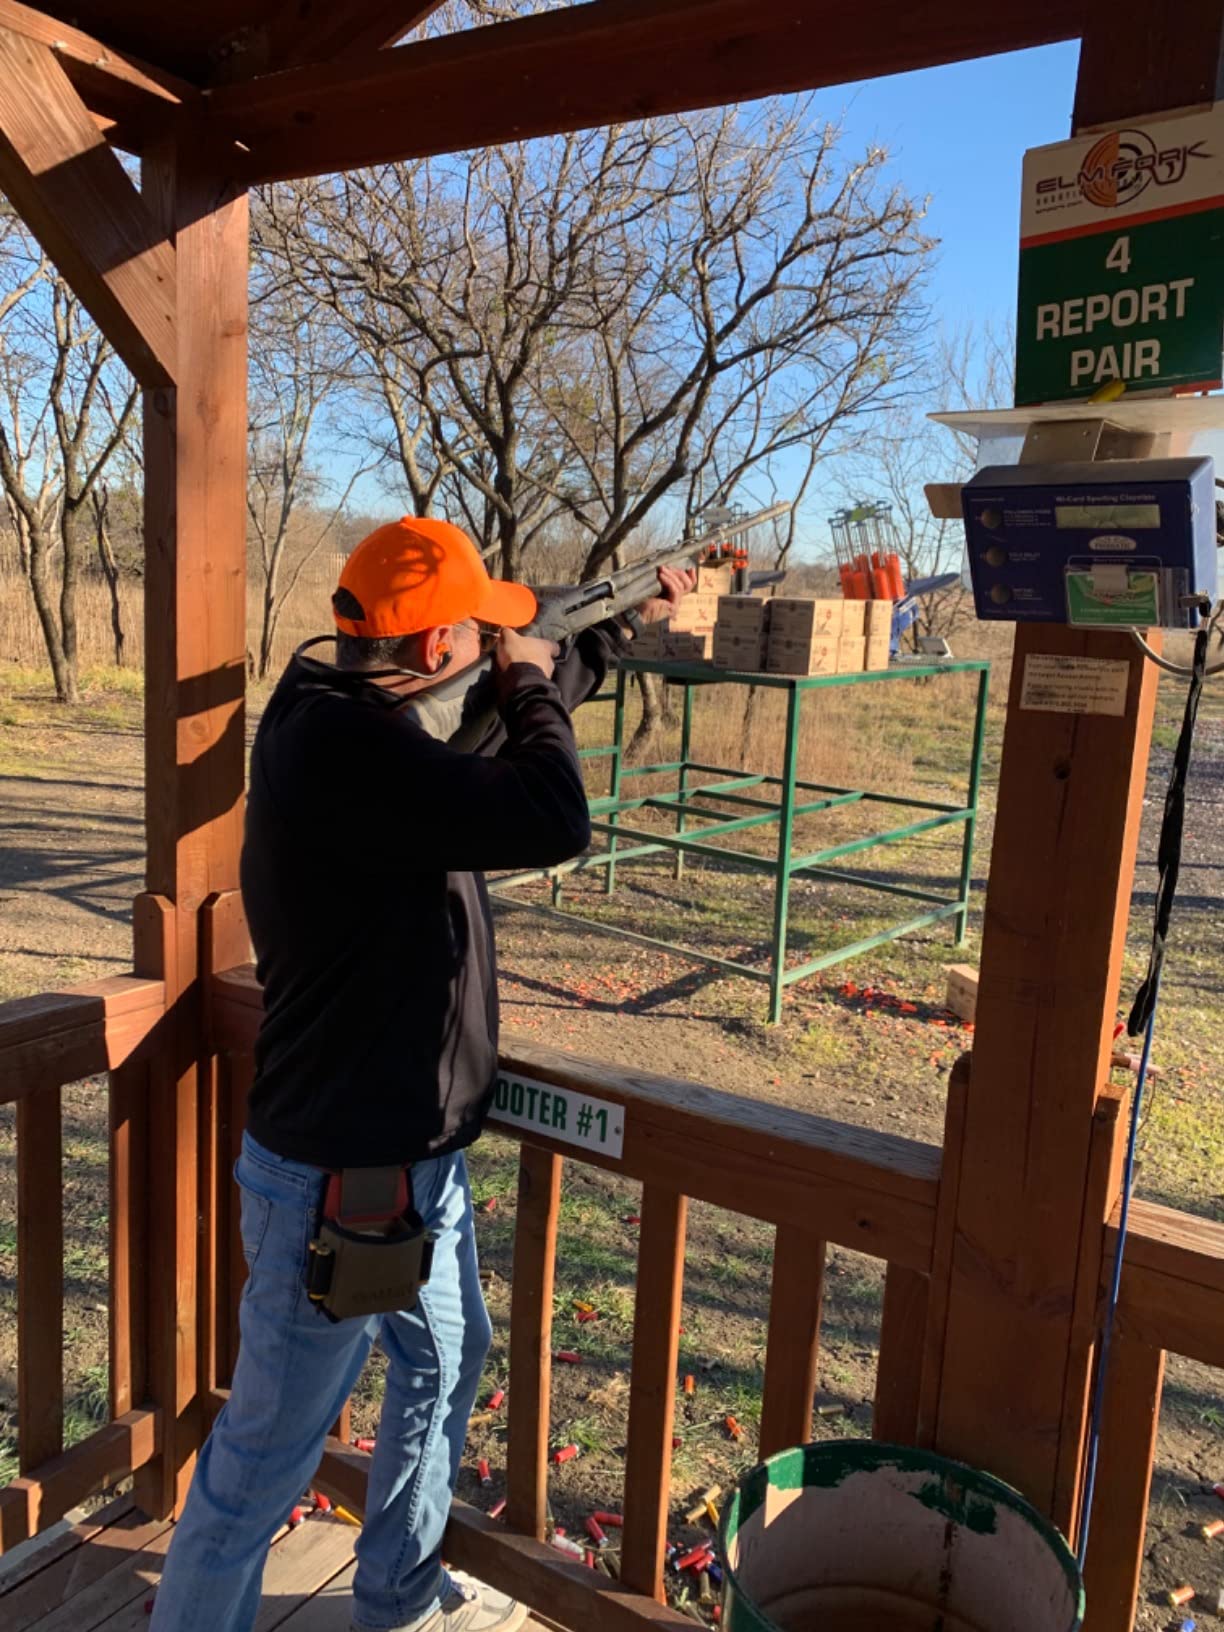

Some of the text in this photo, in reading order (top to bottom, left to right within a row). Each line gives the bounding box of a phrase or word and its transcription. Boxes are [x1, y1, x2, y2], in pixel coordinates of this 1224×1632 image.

[1035, 140, 1213, 194] ELM FORK
[1105, 236, 1131, 273] 4
[1036, 277, 1194, 341] REPORT
[1070, 339, 1161, 386] PAIR
[576, 1103, 608, 1143] #1
